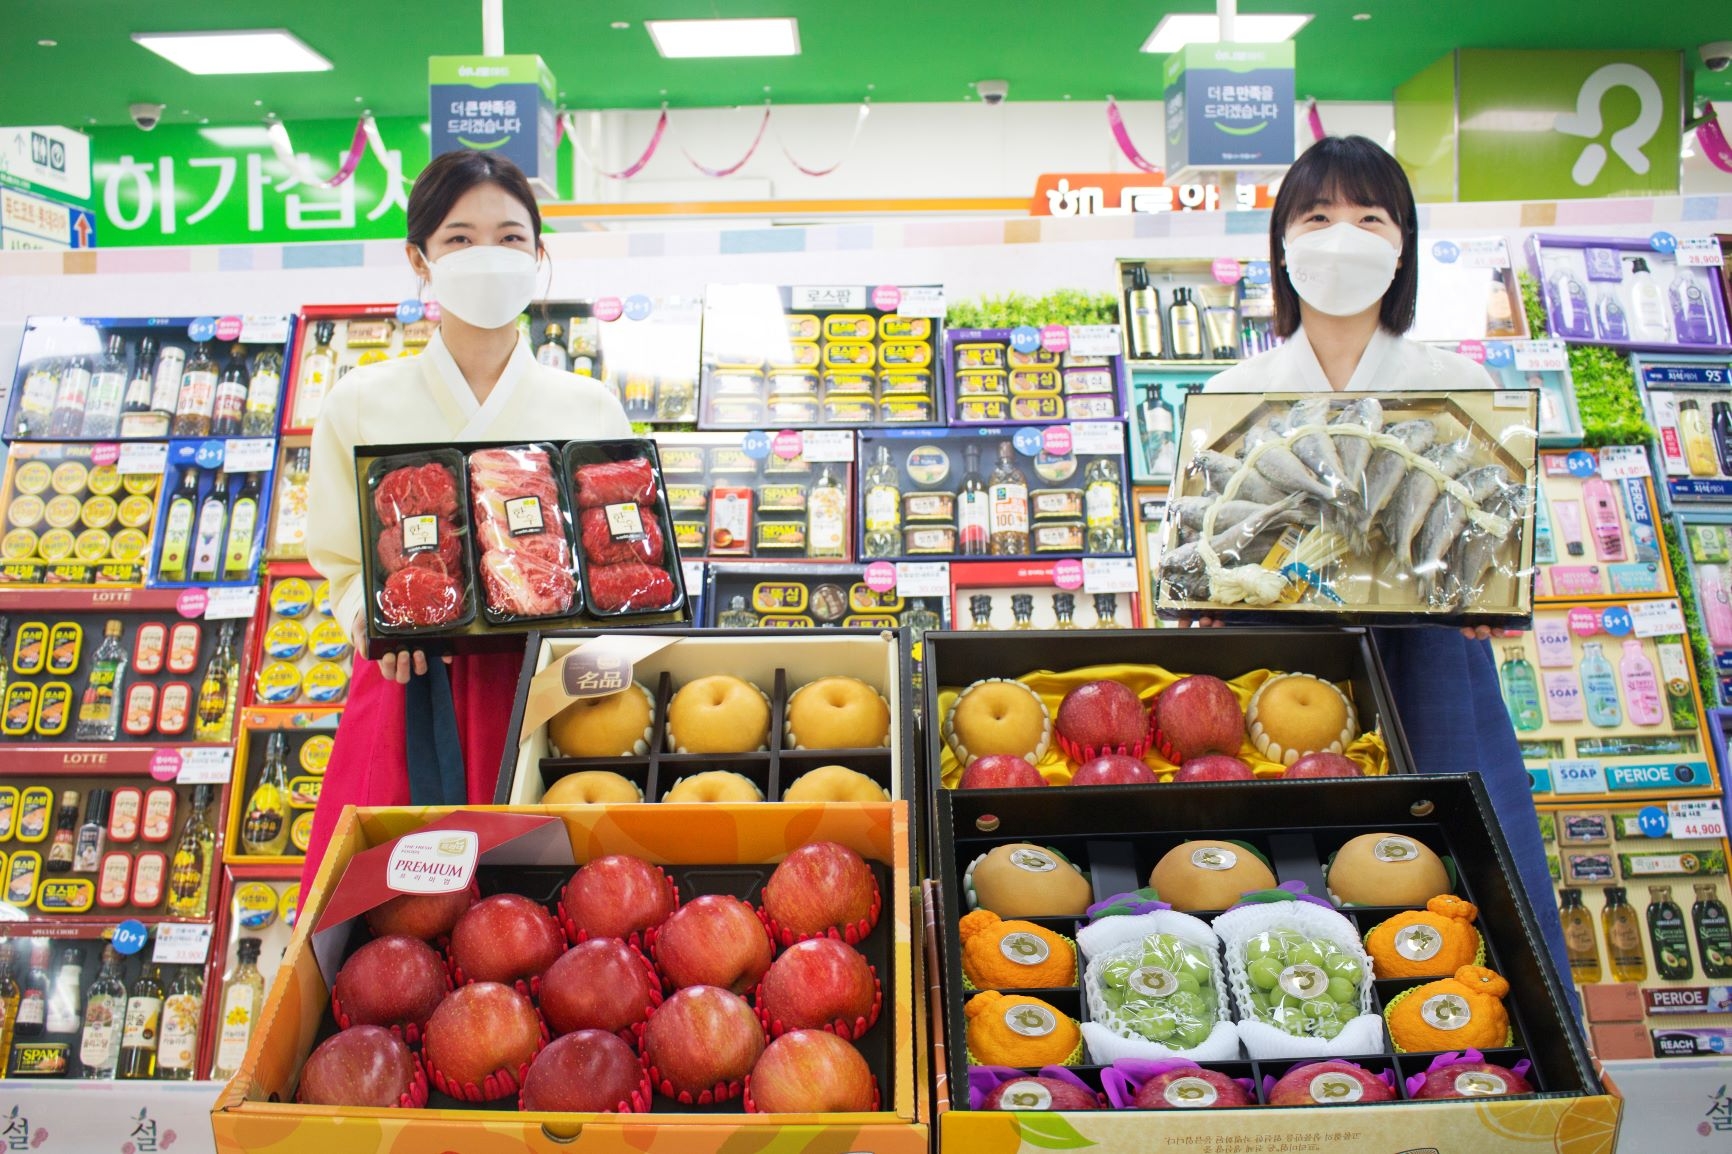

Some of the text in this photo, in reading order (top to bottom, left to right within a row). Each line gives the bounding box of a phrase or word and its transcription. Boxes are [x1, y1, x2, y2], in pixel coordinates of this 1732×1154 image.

[1208, 85, 1274, 102] 더 큰 만족을
[450, 100, 517, 117] 더 큰 만족을
[1204, 103, 1279, 120] 드리겠습니다
[447, 117, 522, 135] 드리겠습니다
[1652, 235, 1676, 248] 1+1
[1688, 254, 1720, 264] 28,900
[1010, 333, 1040, 345] 10+1
[1486, 348, 1511, 360] 5+1
[1016, 436, 1040, 447] 5+1
[66, 447, 93, 457] PREM
[198, 448, 223, 461] 3+1
[1568, 457, 1593, 470] 5+1
[1628, 479, 1649, 521] PERIOE
[764, 524, 797, 536] SPAM
[92, 591, 131, 602] LOTTE
[1604, 615, 1630, 628] 5+1
[1540, 635, 1568, 645] SOAP
[576, 670, 622, 690] 名品
[1549, 688, 1578, 698] SOAP
[63, 753, 108, 765] LOTTE
[1560, 768, 1598, 780] SOAP
[1614, 766, 1671, 783] PERIOE
[1641, 814, 1667, 829] 1+1
[1684, 823, 1722, 835] 44,900
[395, 859, 464, 879] PREMIUM
[112, 927, 146, 948] 10+1
[1653, 991, 1704, 1006] PERIOE
[1660, 1039, 1695, 1050] REACH
[23, 1049, 59, 1061] SPAM
[2, 1116, 29, 1152] 설
[130, 1116, 157, 1153] 설
